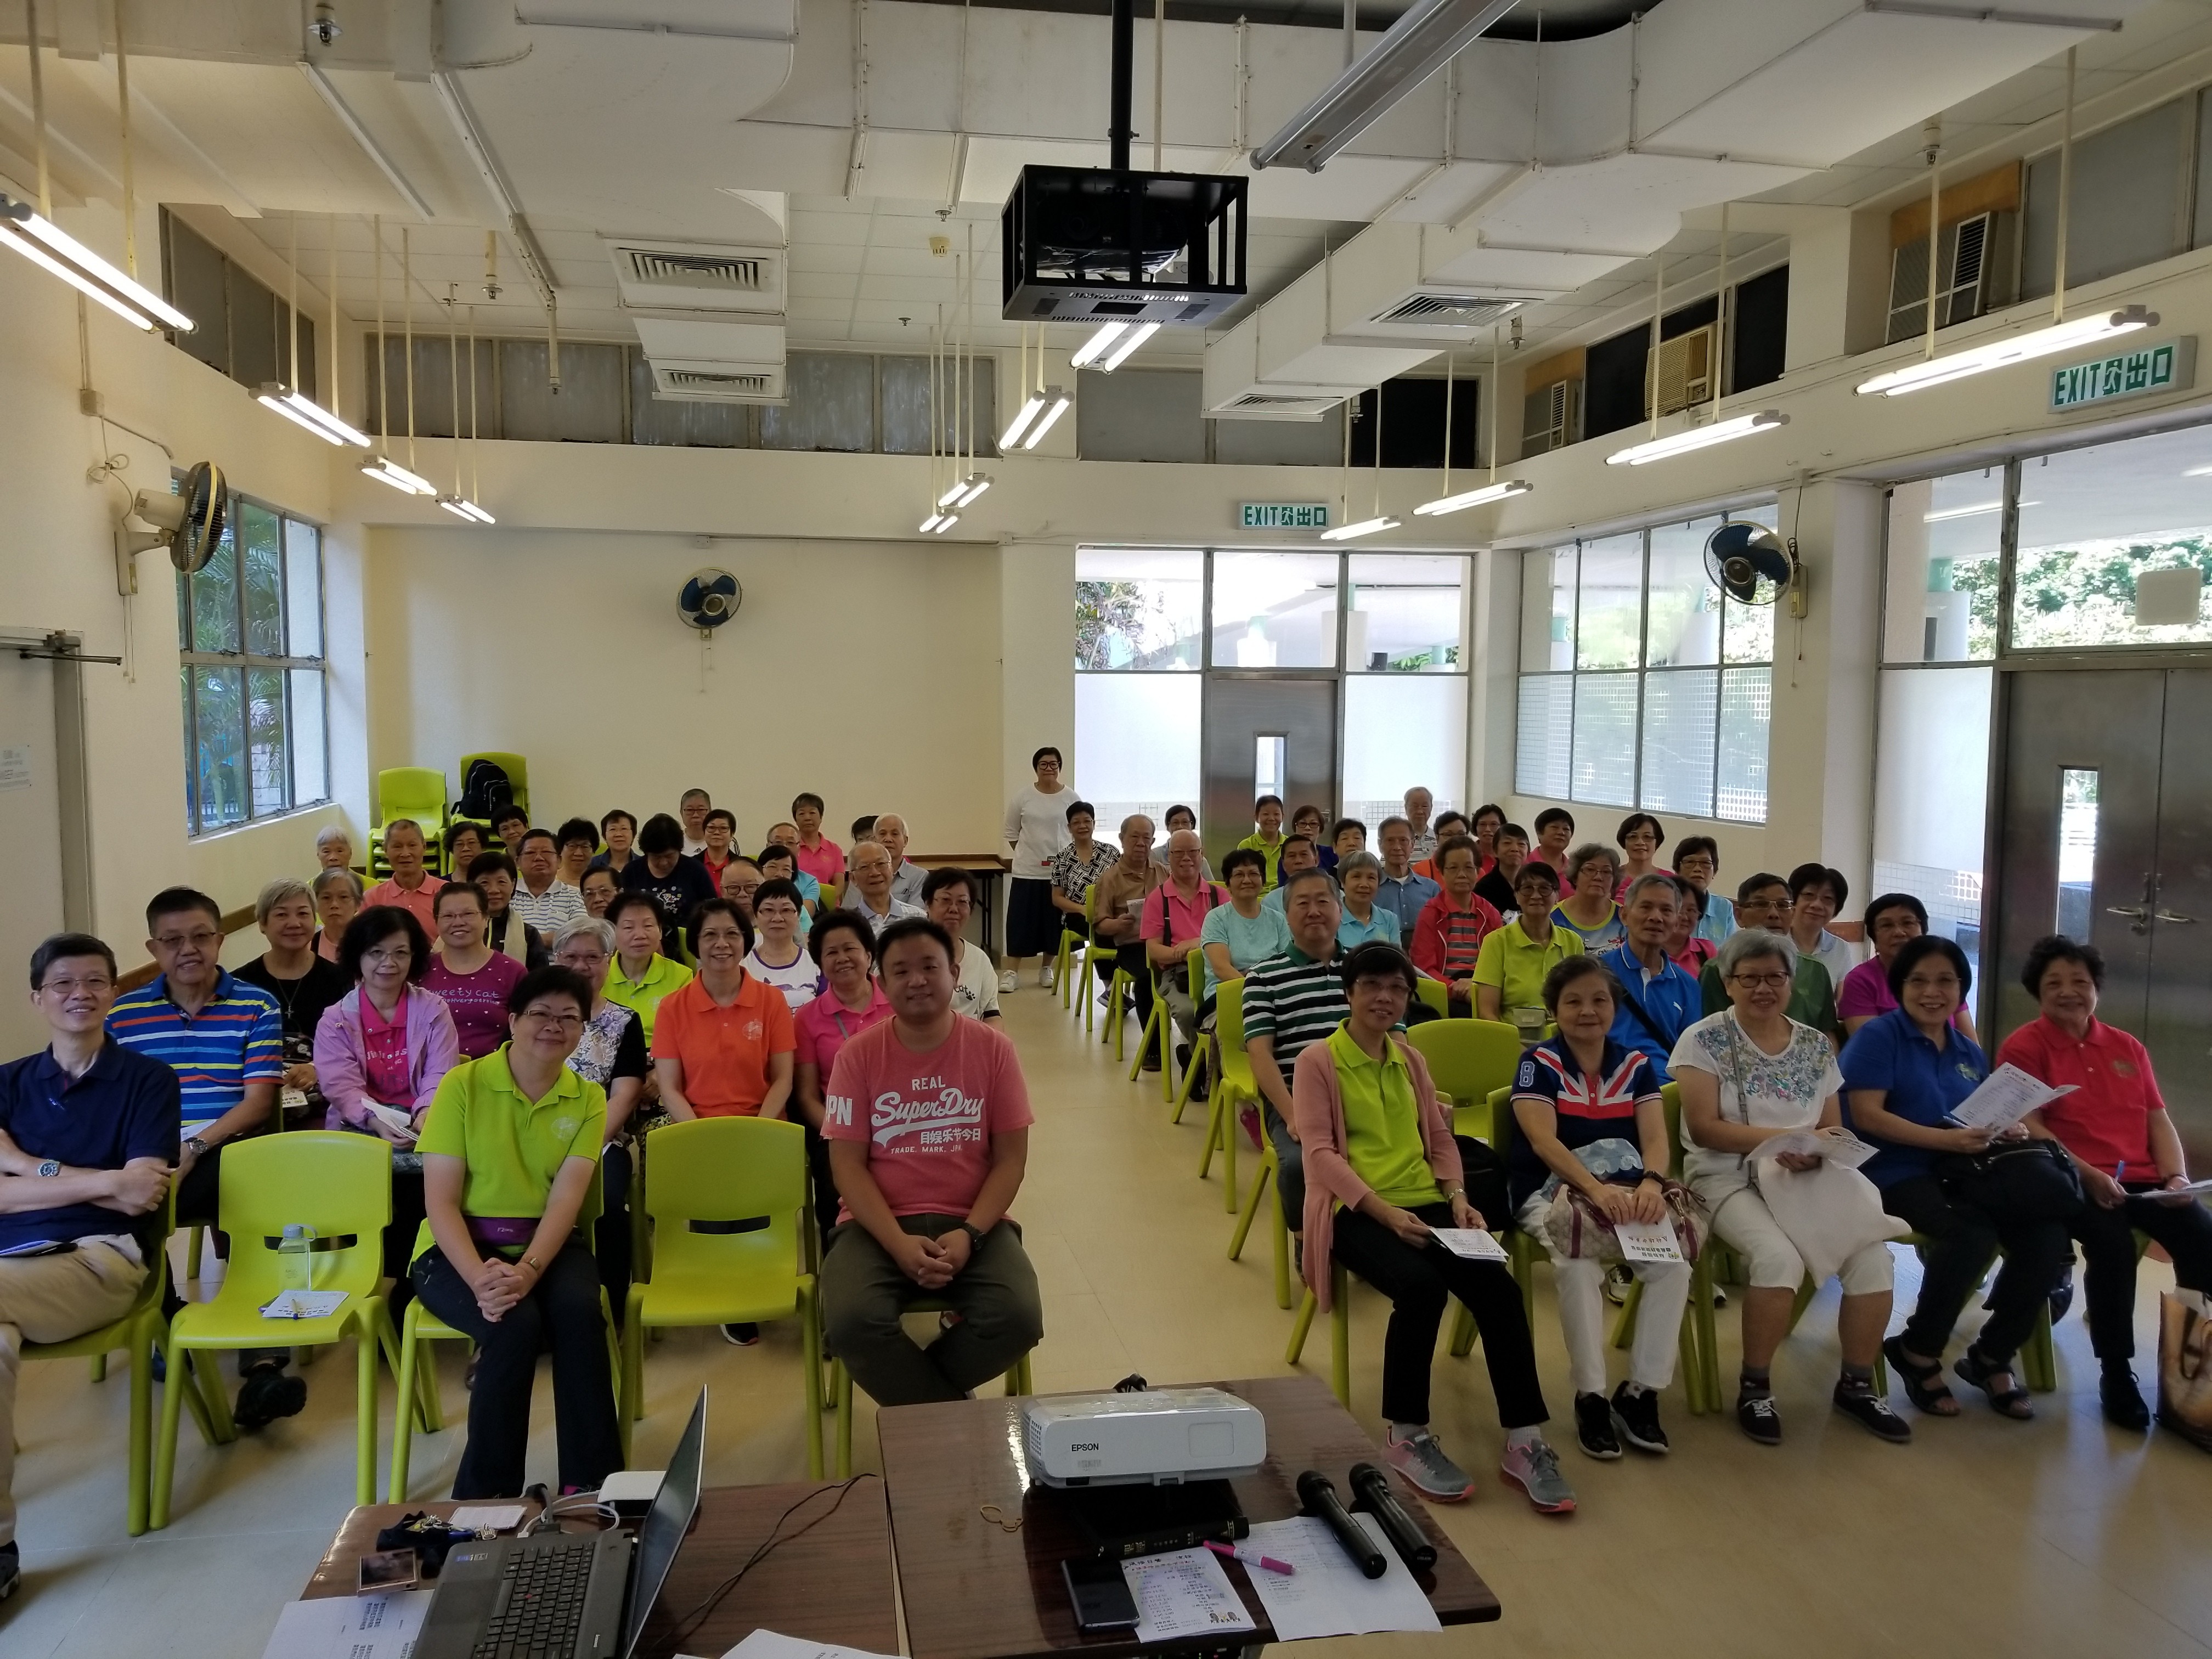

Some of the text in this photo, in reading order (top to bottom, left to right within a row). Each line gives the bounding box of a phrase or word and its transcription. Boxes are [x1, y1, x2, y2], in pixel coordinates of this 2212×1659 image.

[2125, 346, 2173, 391] 出口
[2054, 363, 2101, 406] EXIT
[1244, 506, 1278, 526] EXIT
[1297, 506, 1327, 527] 出口
[912, 1075, 946, 1091] REAL
[826, 1095, 853, 1126] PN
[871, 1088, 984, 1128] SuperDry
[1071, 1443, 1099, 1452] EPSON
